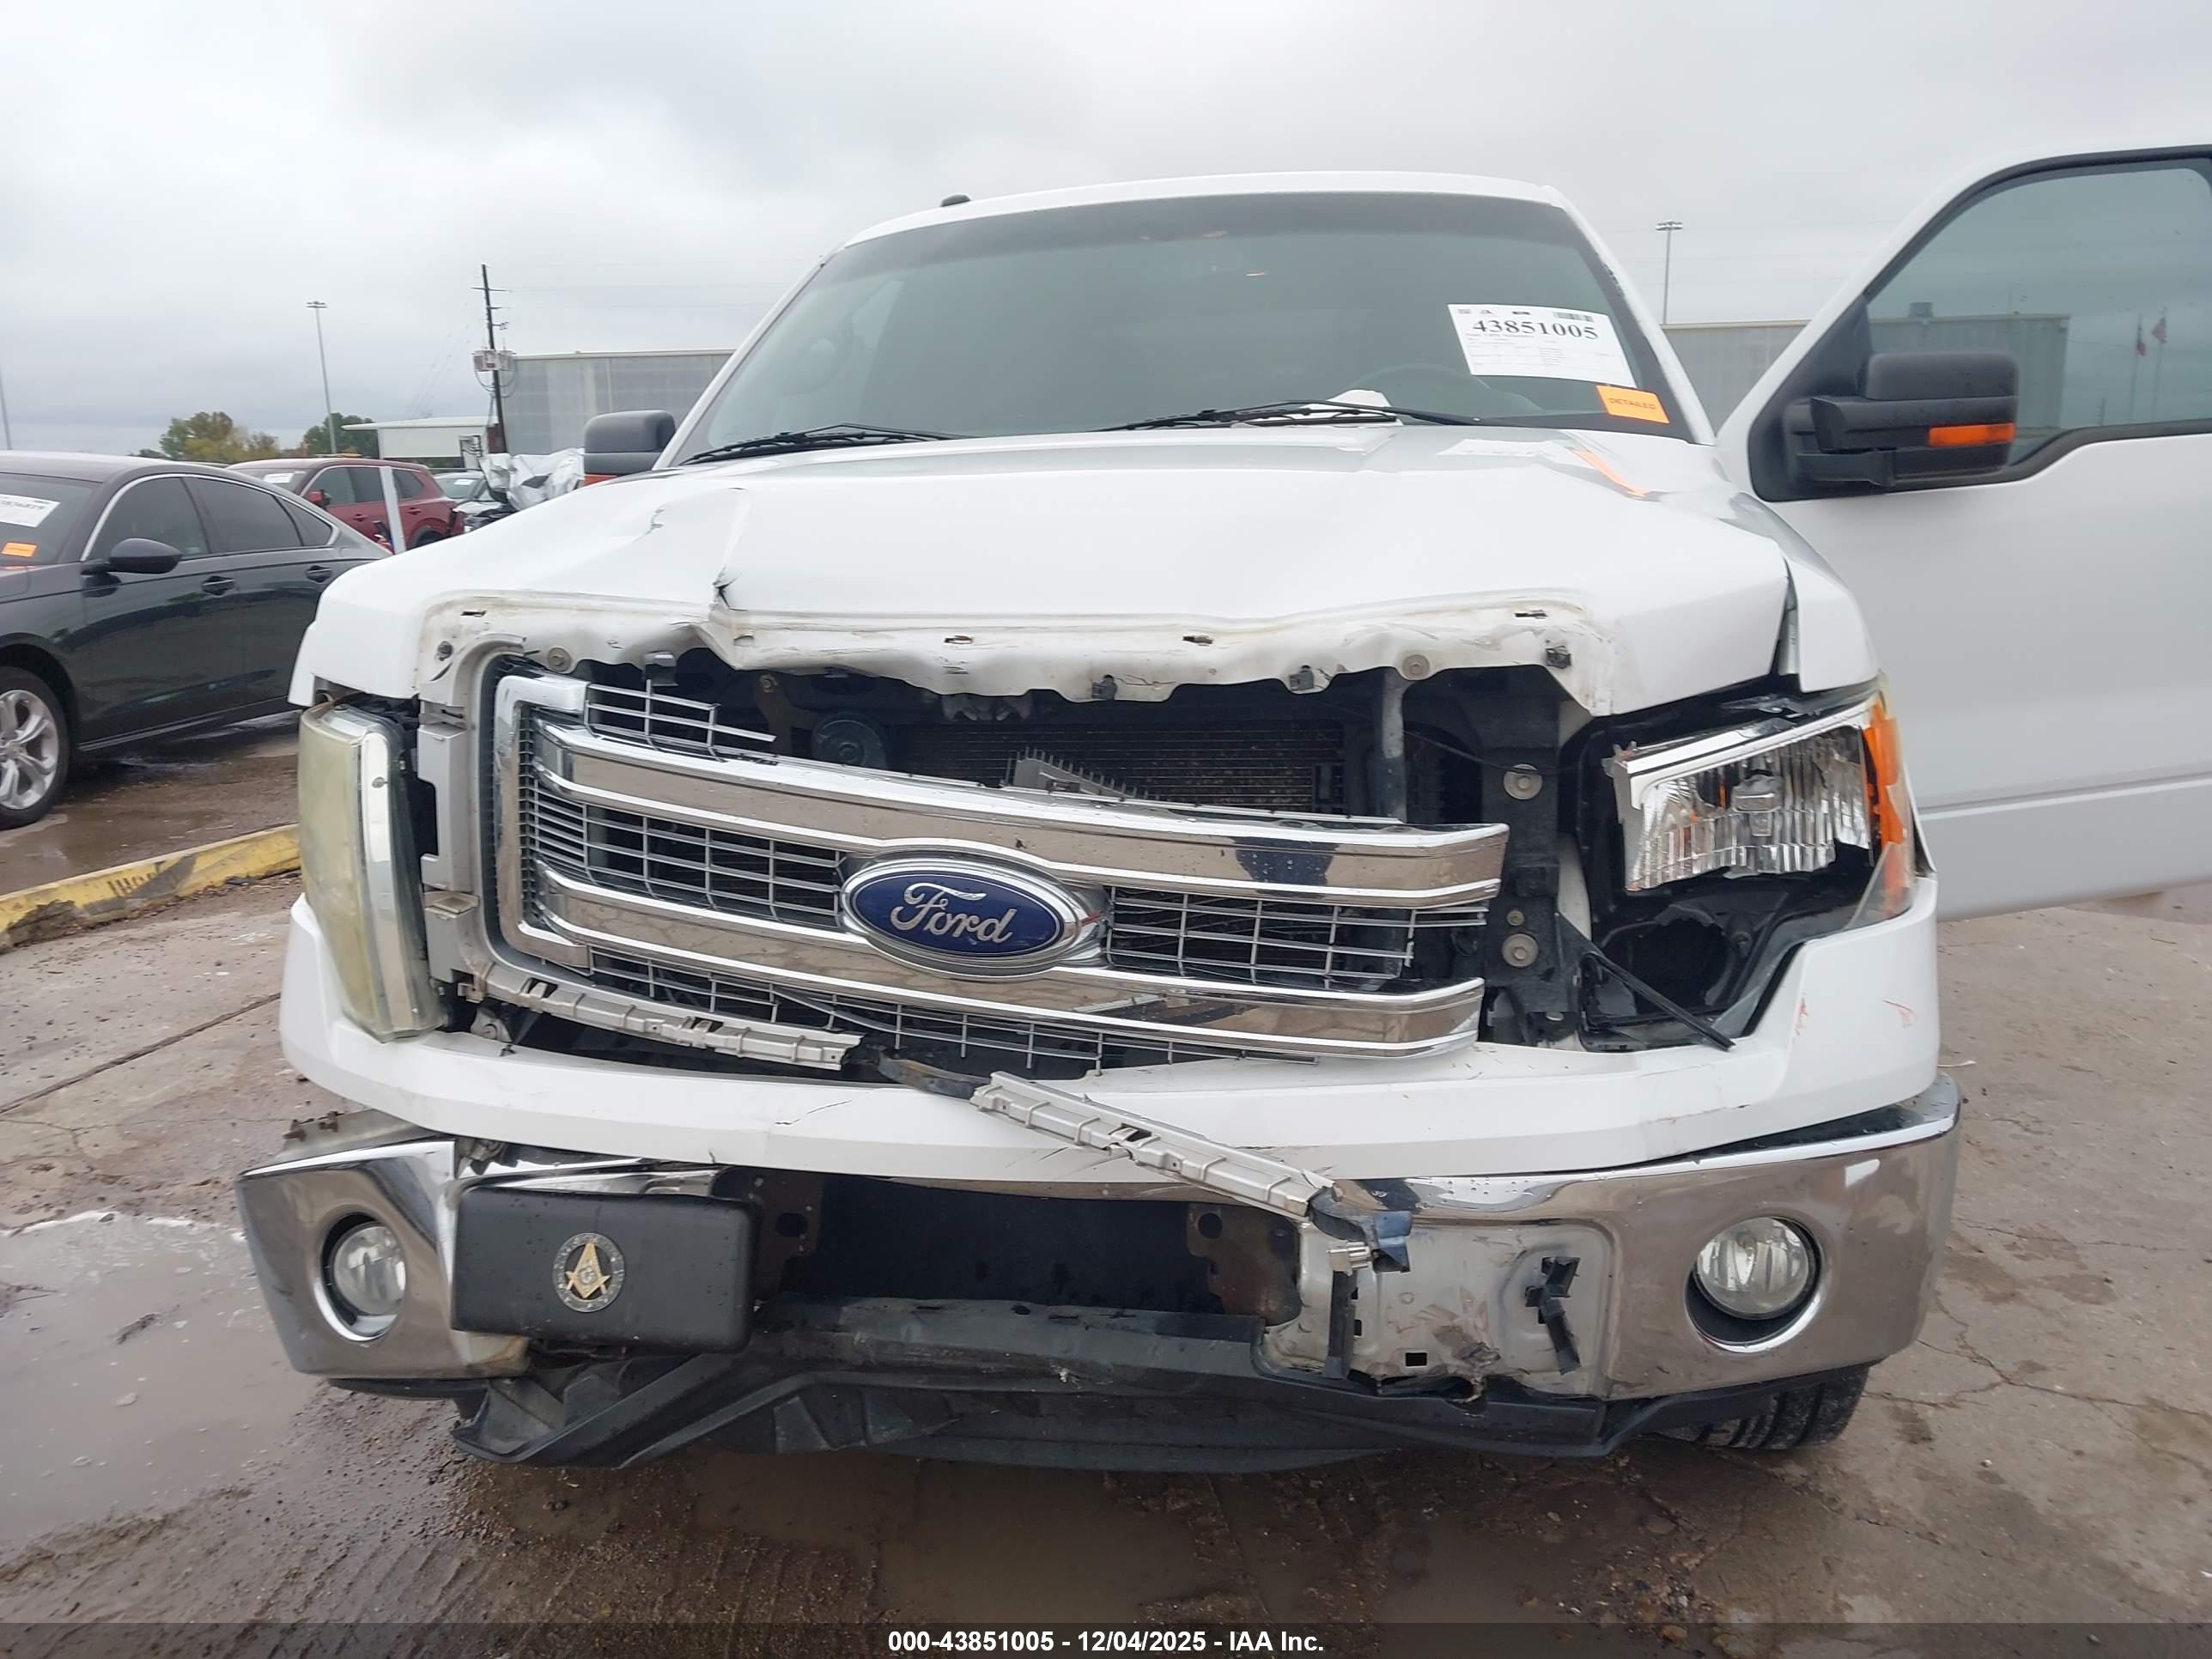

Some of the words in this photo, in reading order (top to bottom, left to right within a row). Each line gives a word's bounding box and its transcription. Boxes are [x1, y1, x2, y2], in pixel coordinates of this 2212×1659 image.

[1473, 319, 1598, 340] 43851005
[1607, 398, 1656, 410] DETAILED
[890, 882, 1018, 943] Ford
